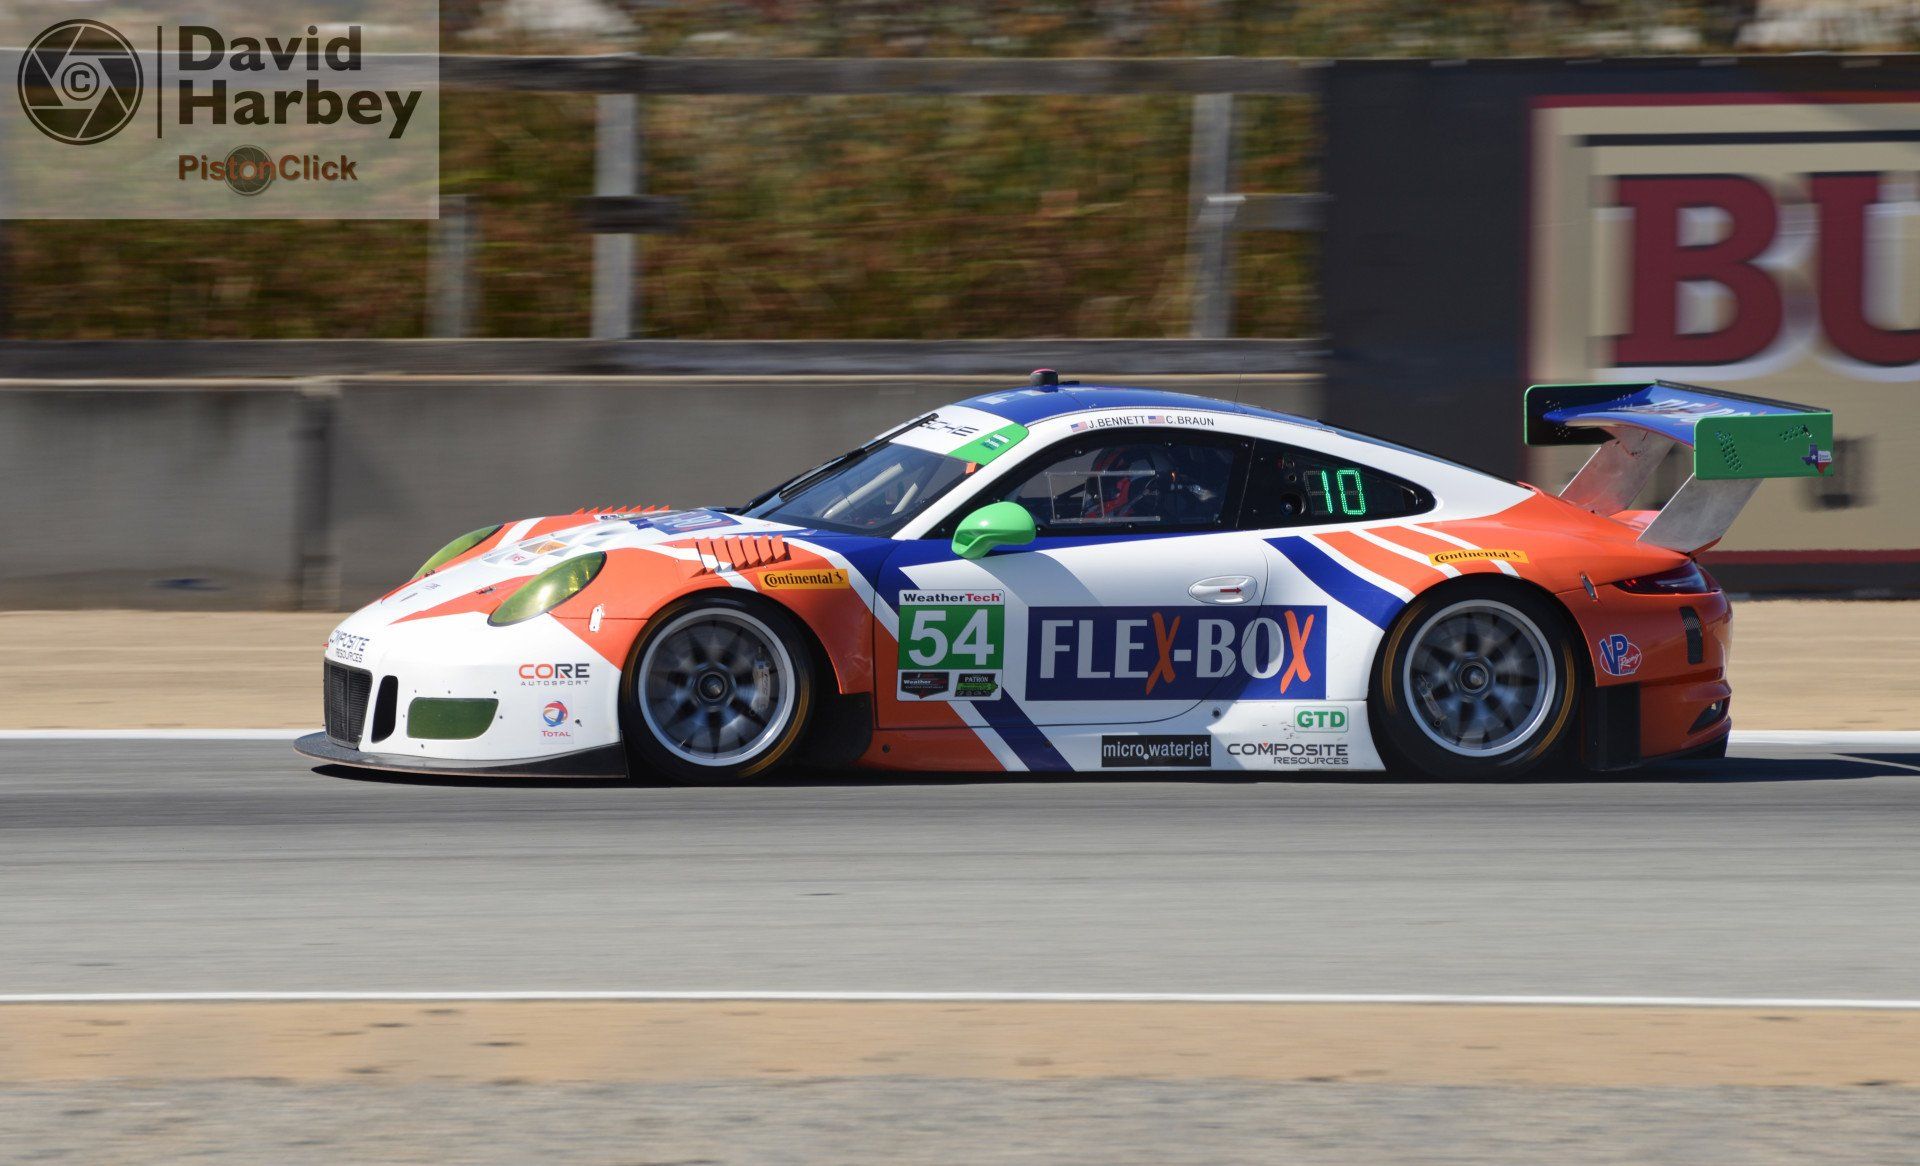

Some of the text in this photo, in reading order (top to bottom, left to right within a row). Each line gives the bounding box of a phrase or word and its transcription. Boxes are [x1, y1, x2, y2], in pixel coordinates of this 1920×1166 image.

[1319, 469, 1365, 514] 10
[1434, 549, 1508, 563] Continental
[764, 569, 834, 588] Continental
[904, 593, 1000, 602] WeatherTech
[908, 609, 995, 667] 54
[1039, 609, 1314, 695] FLEX-BOX
[1599, 634, 1629, 676] VP
[519, 663, 590, 679] CORE
[1296, 711, 1345, 728] GTD
[1227, 743, 1348, 756] COMPOSITE
[1274, 756, 1349, 765] RESOURCES
